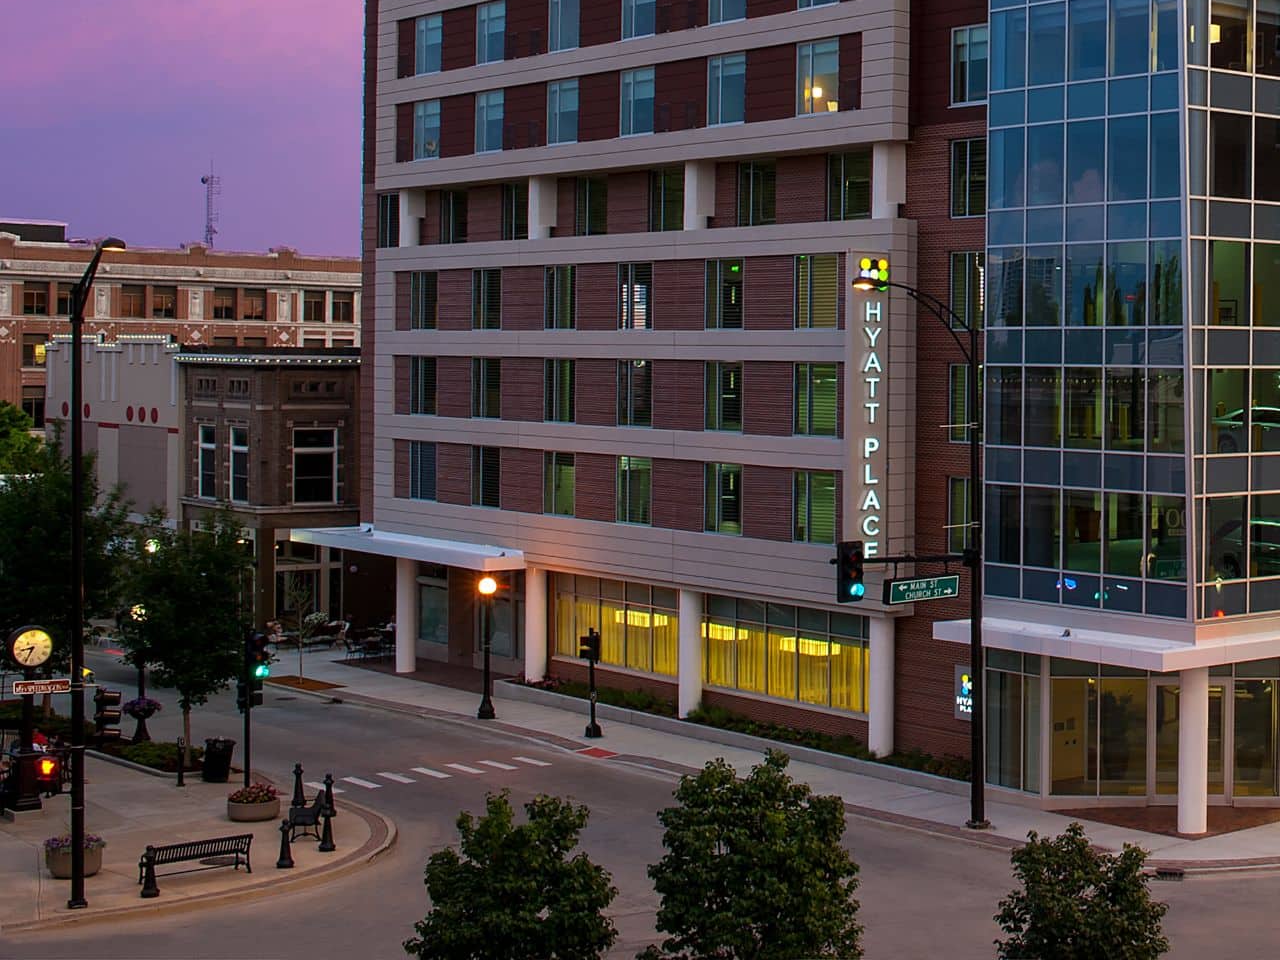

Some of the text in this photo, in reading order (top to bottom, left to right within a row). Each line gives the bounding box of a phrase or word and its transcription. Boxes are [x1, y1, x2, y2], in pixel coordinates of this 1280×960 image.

[864, 301, 882, 424] HYATT
[909, 580, 938, 591] MAIN ST
[904, 588, 943, 600] CHURCH ST
[956, 695, 973, 706] HYA
[959, 704, 973, 713] PLA
